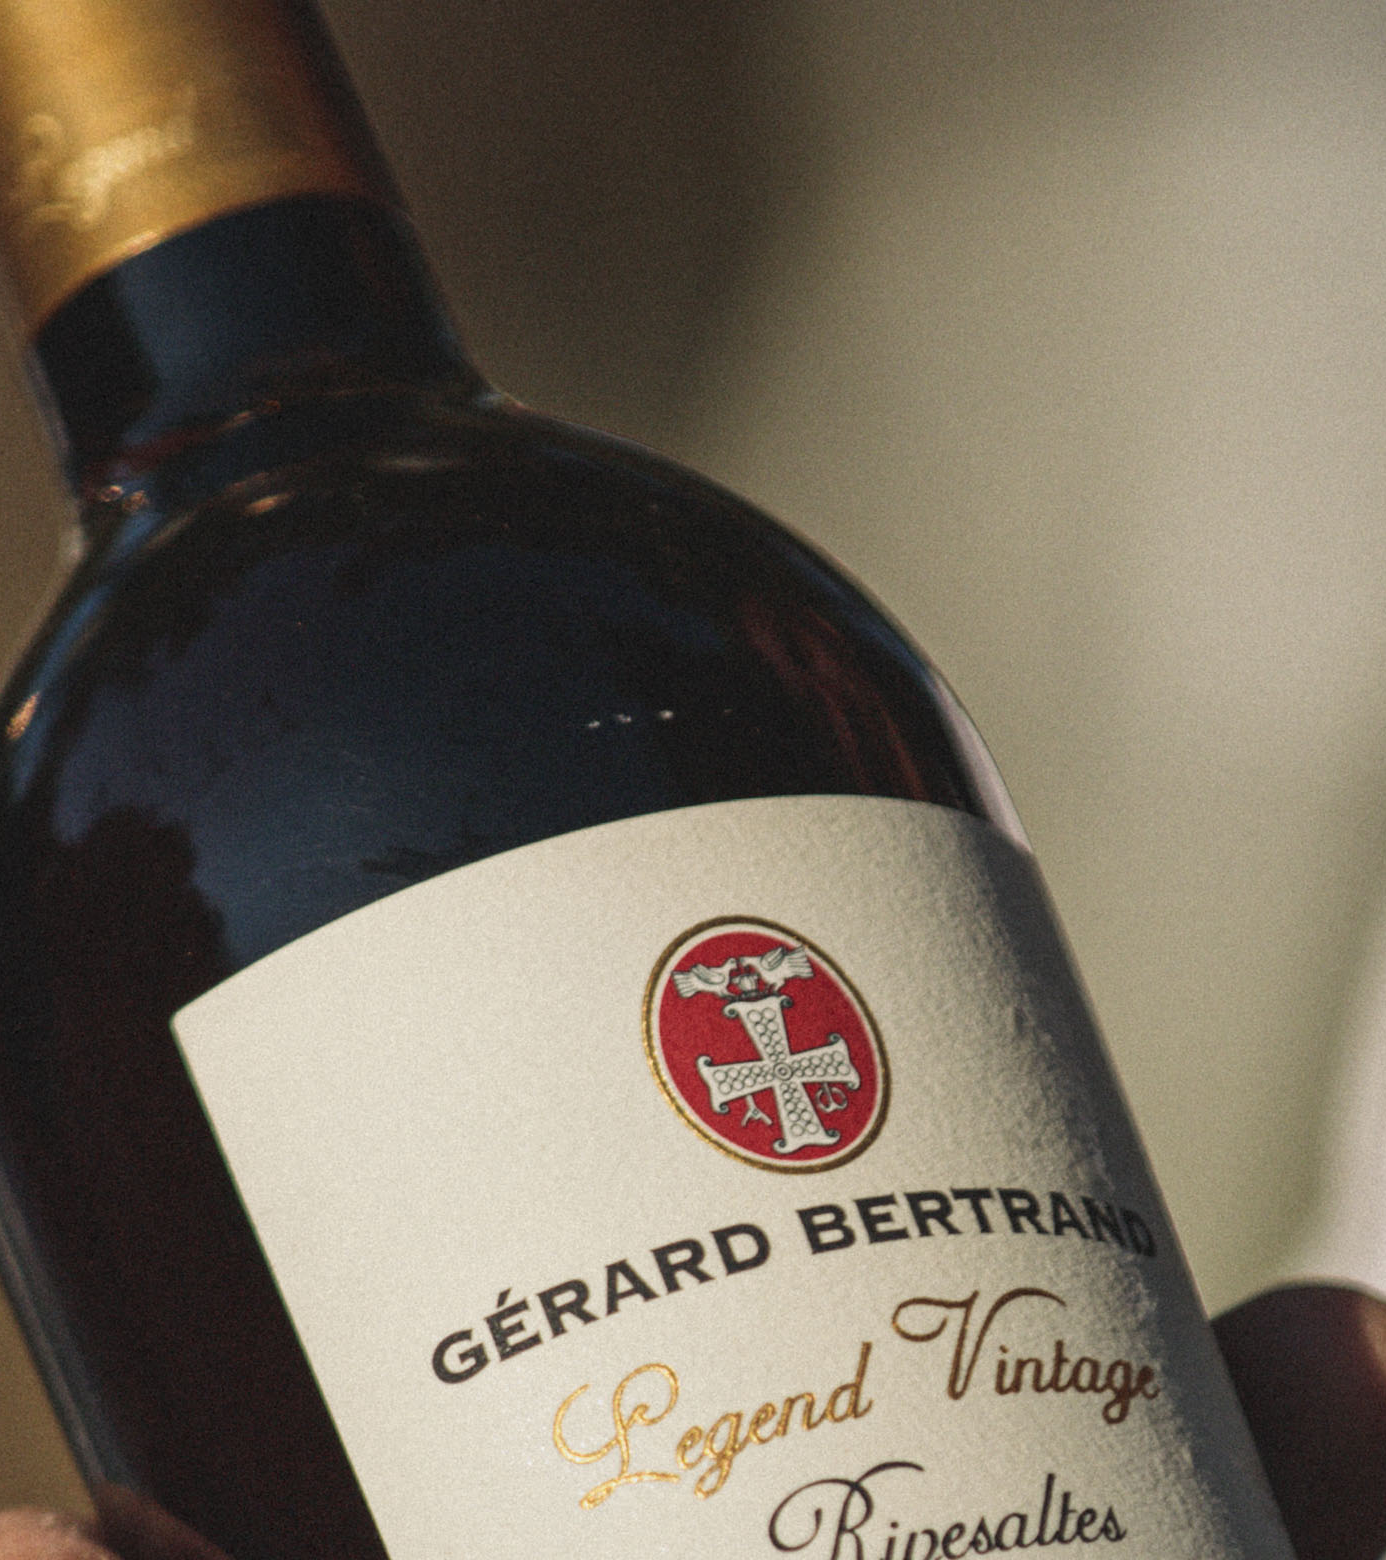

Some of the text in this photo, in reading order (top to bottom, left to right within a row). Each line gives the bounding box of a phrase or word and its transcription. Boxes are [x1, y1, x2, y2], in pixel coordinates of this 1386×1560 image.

[431, 1186, 1157, 1385] GÉRARD BERTRAND
[553, 1286, 1161, 1511] Legend Vintage
